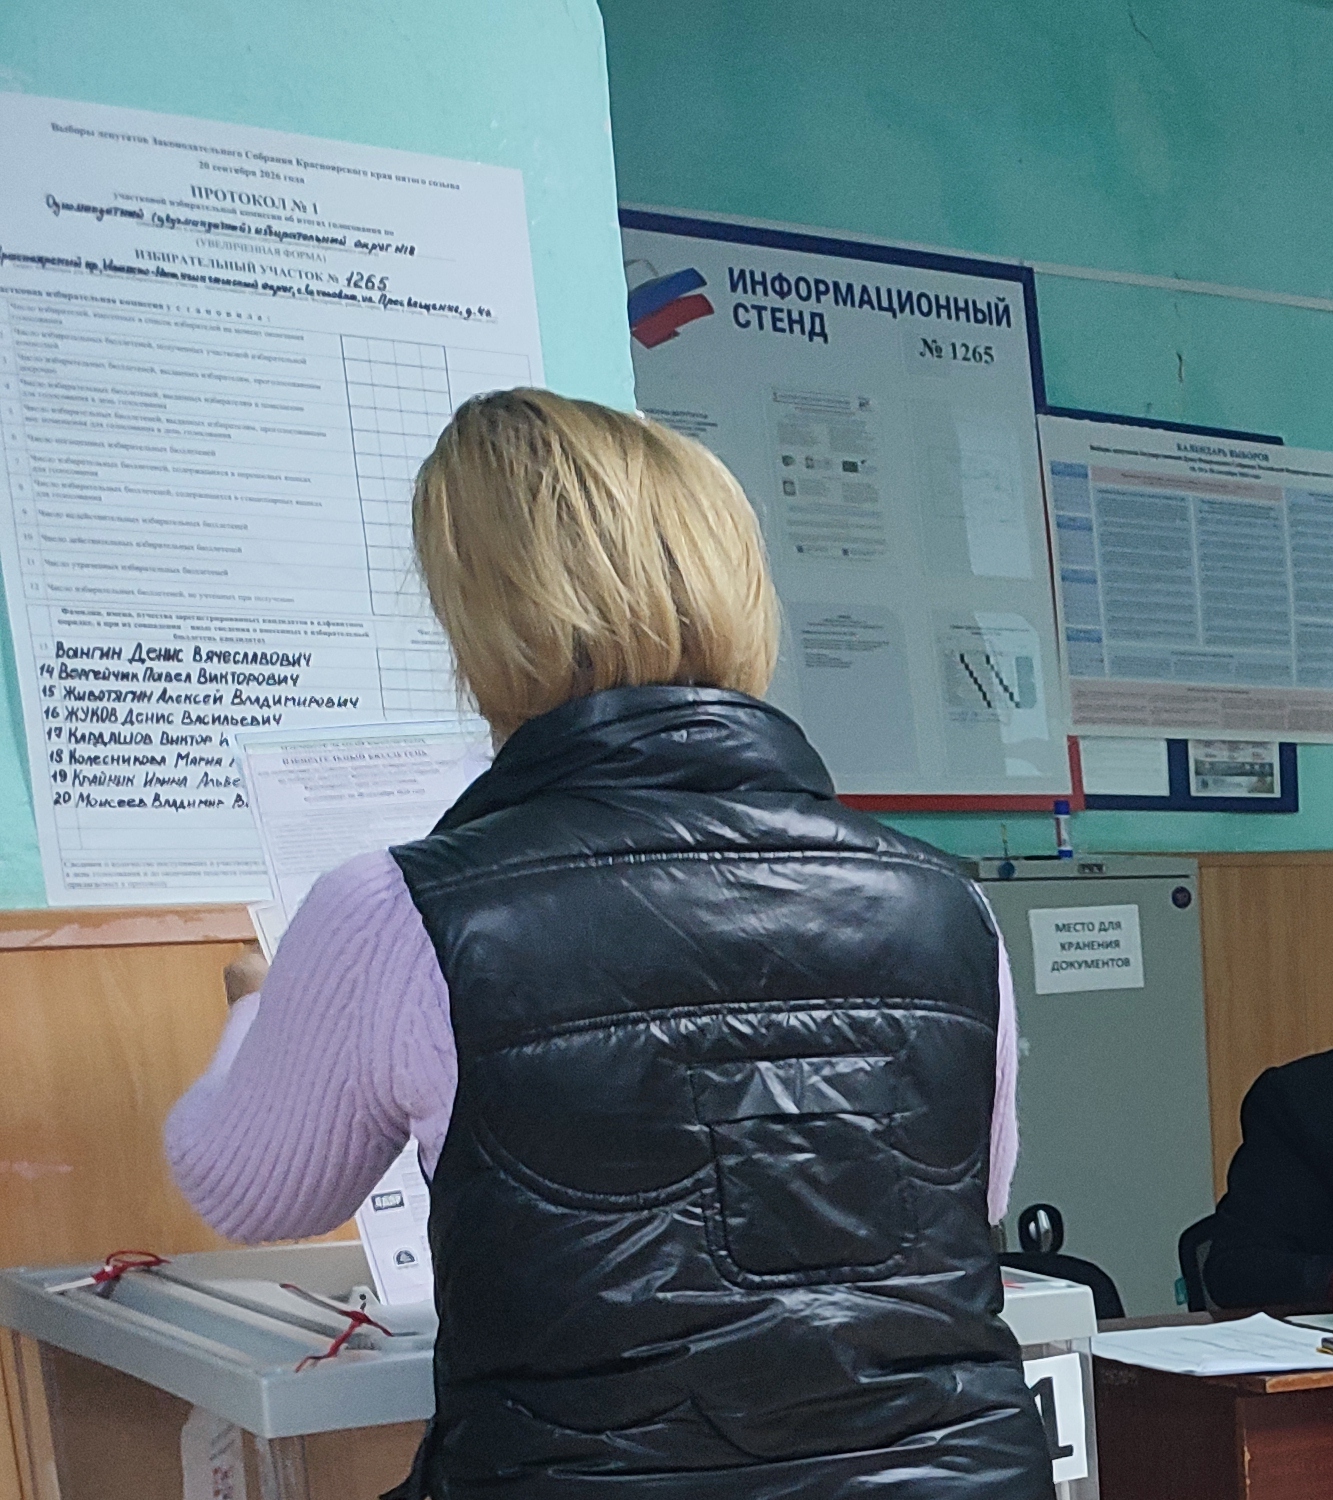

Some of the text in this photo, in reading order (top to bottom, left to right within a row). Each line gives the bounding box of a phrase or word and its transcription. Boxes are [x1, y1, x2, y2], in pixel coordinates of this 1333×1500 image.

[191, 184, 319, 215] ПРОТОКОЛ № 1
[135, 248, 256, 274] ИЗБИРАТЕЛЬНЫЙ
[259, 264, 322, 281] УЧАСТОК
[345, 271, 388, 291] 1265
[728, 266, 1012, 328] ИНФОРМАЦИОННЫЙ
[733, 302, 828, 344] СТЕНД
[920, 338, 995, 364] № 1265
[39, 663, 54, 679] 14
[41, 684, 56, 697] 15
[43, 705, 59, 720] 16
[46, 726, 63, 741] 17
[49, 748, 63, 764] 18
[51, 768, 67, 784] 19
[53, 790, 71, 806] 20
[1055, 920, 1122, 933] МЕСТО ДЛЯ
[1059, 939, 1120, 952] ХРАНЕНИЯ
[1051, 957, 1130, 973] ДОКУМЕНТОВ
